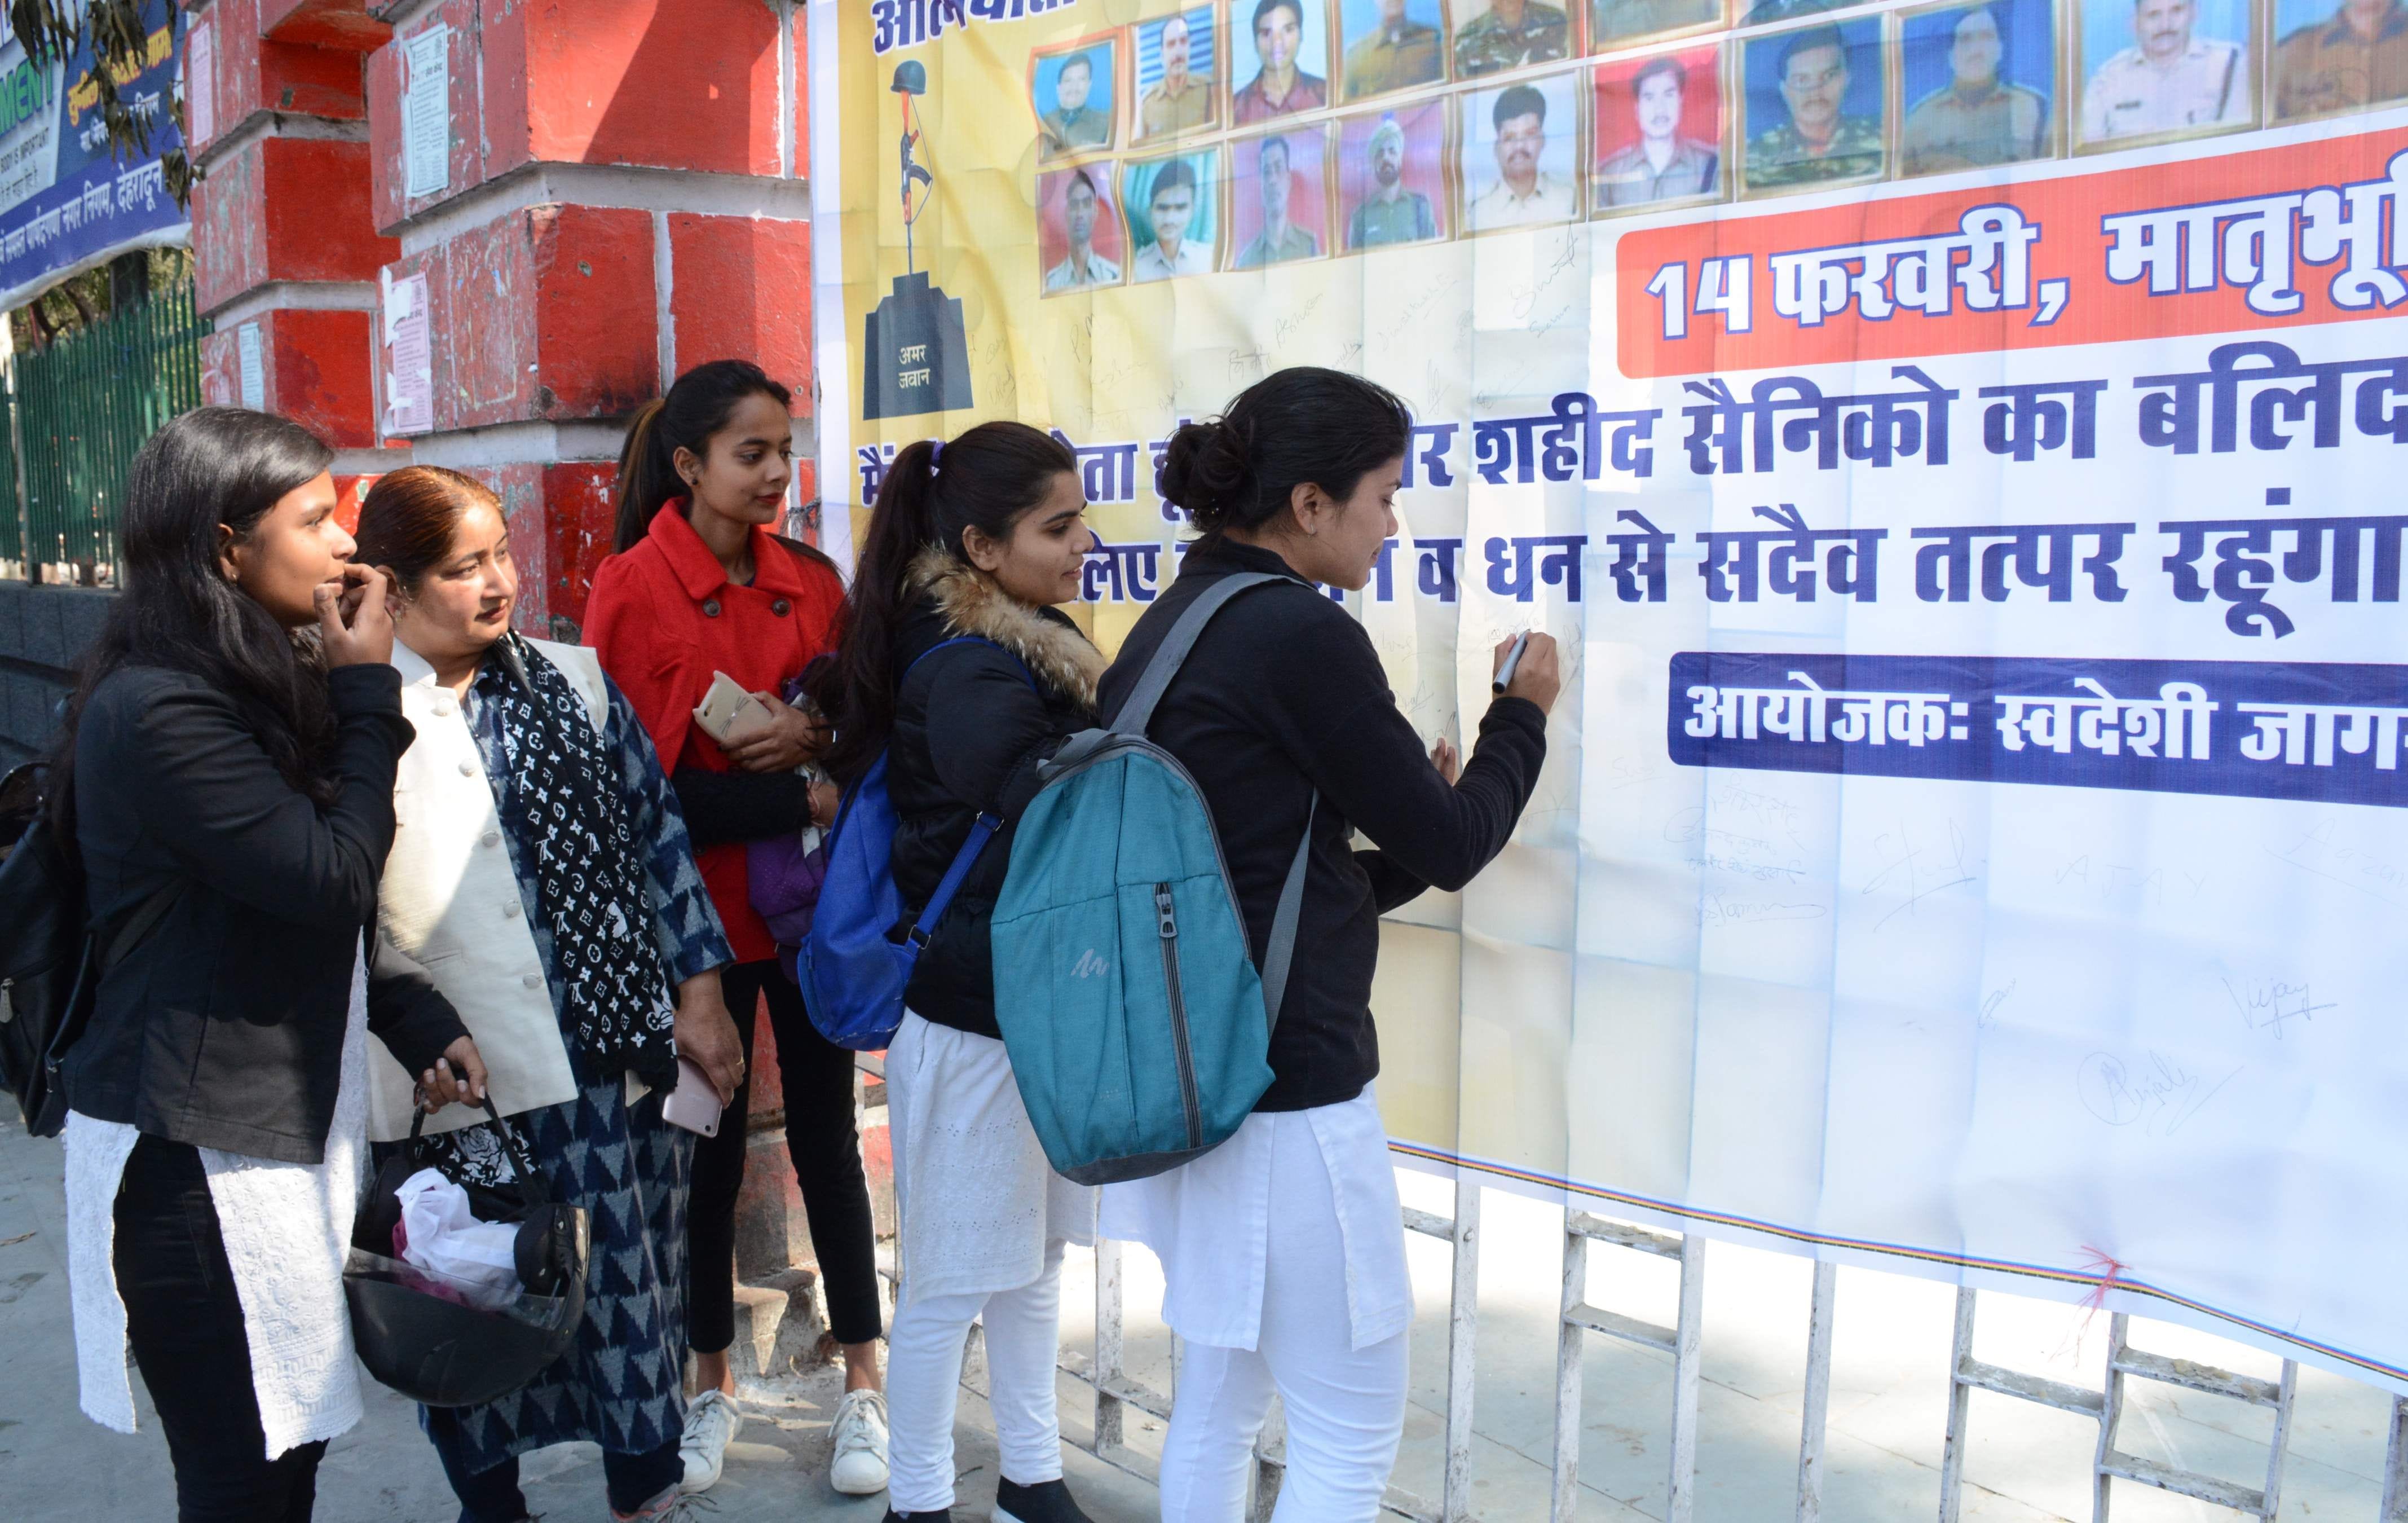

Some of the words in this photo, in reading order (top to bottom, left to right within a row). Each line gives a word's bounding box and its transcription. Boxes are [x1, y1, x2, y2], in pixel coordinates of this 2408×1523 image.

[61, 196, 83, 233] नगर
[117, 161, 162, 212] देहरादून
[1643, 253, 1753, 341] 14
[899, 345, 927, 365] अमर
[899, 368, 930, 389] जवान
[1473, 393, 1663, 485] शहीद
[1978, 379, 2108, 461] का
[1413, 539, 1462, 602] व
[1484, 535, 1588, 602] धन
[1606, 509, 1675, 602] से
[1696, 503, 1888, 602] सदैव
[1911, 522, 2136, 602] तत्पर
[1995, 677, 2219, 760] स्वदेशी
[2237, 702, 2408, 770] जाग
